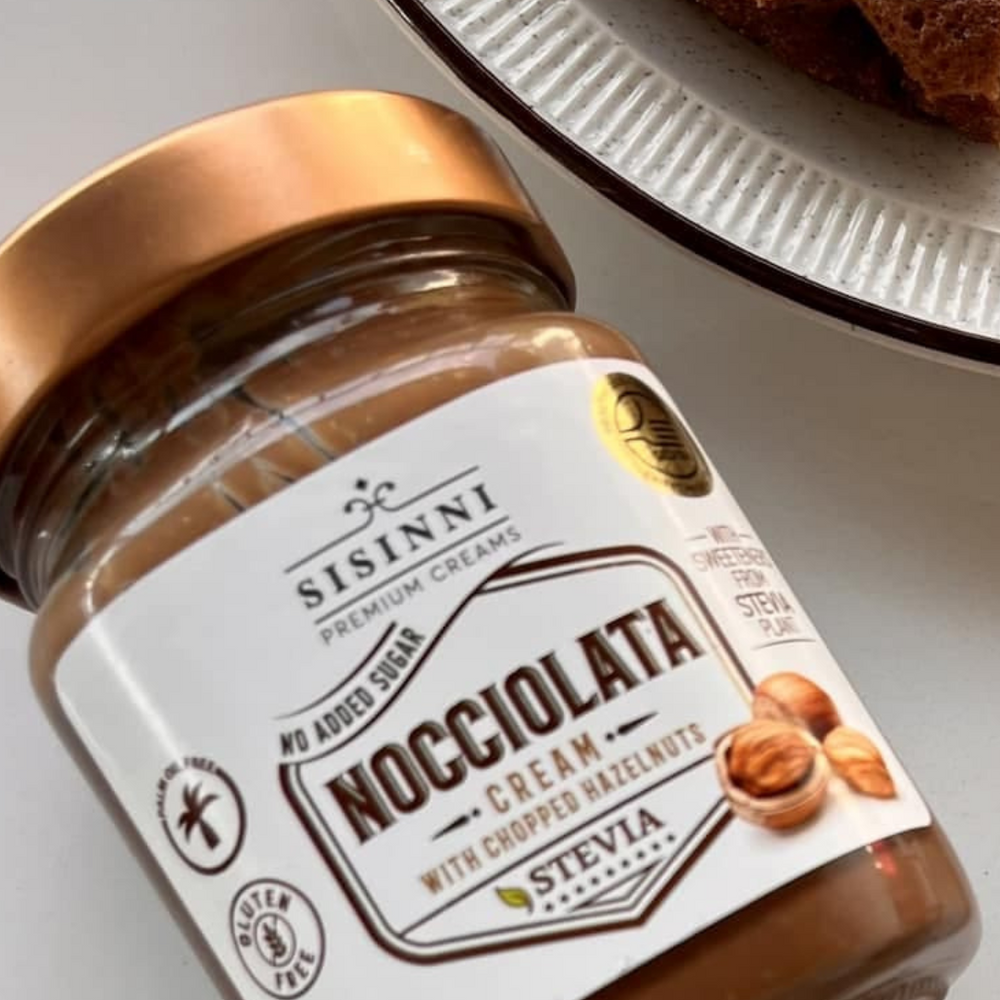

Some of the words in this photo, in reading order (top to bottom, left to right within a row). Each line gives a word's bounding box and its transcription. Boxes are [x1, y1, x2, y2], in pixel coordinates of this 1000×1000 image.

[297, 483, 497, 610] SISINNI
[320, 578, 425, 645] PREMIUM
[430, 525, 522, 583] CREAMS
[279, 728, 309, 757] NO
[313, 687, 375, 744] ADDED
[368, 626, 426, 692] SUGAR
[324, 597, 707, 846] NOCCIOLATA
[420, 852, 482, 895] WITH
[482, 790, 581, 858] CHOPPED
[580, 723, 707, 803] HAZELNUTS
[485, 732, 603, 814] CREAM
[529, 807, 665, 896] STEVIA
[237, 889, 292, 948] GLUTEN
[275, 948, 315, 990] FREE
